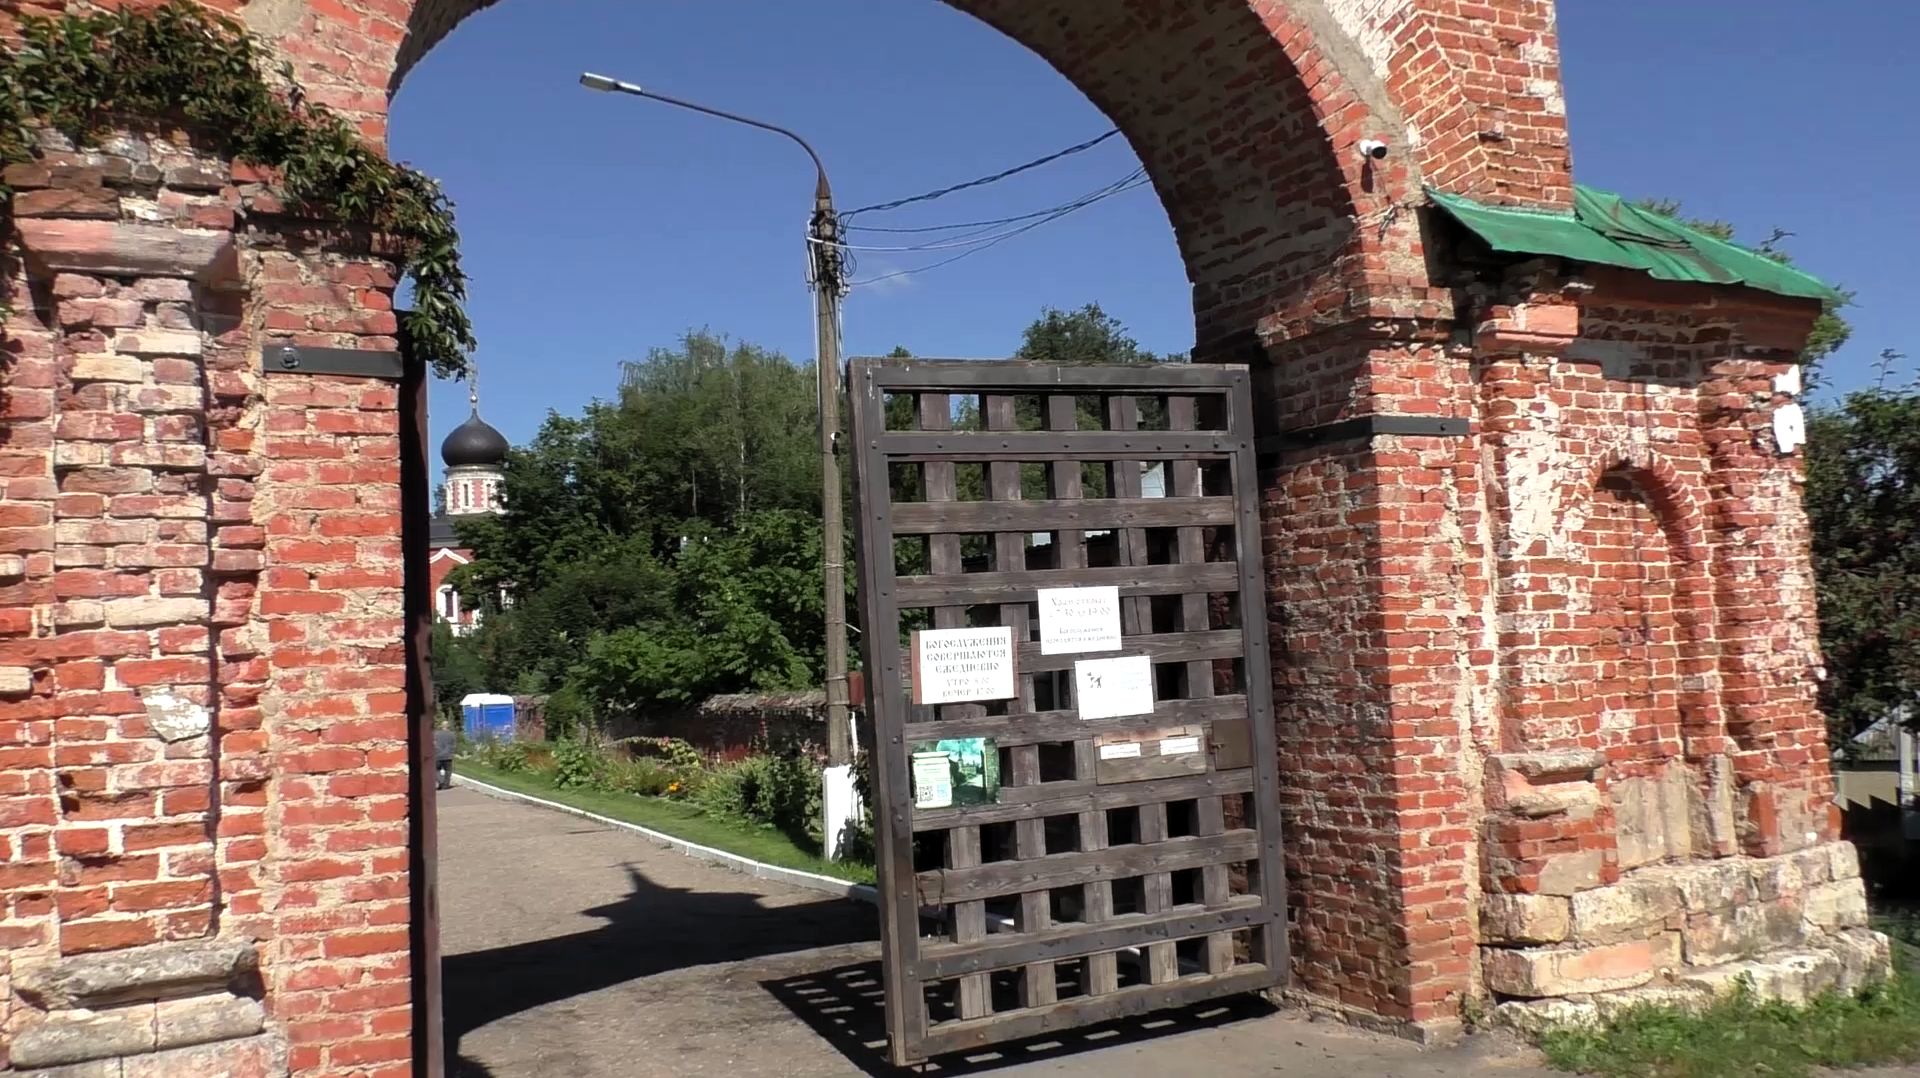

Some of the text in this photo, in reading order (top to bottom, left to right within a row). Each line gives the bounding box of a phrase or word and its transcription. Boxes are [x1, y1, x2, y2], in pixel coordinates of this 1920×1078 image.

[926, 637, 1006, 650] БОГОСЛУЖЕНИЯ
[927, 649, 1006, 661] СОВЕРШАЮТСЯ
[936, 662, 999, 674] ЕЖЕДНЕВНО
